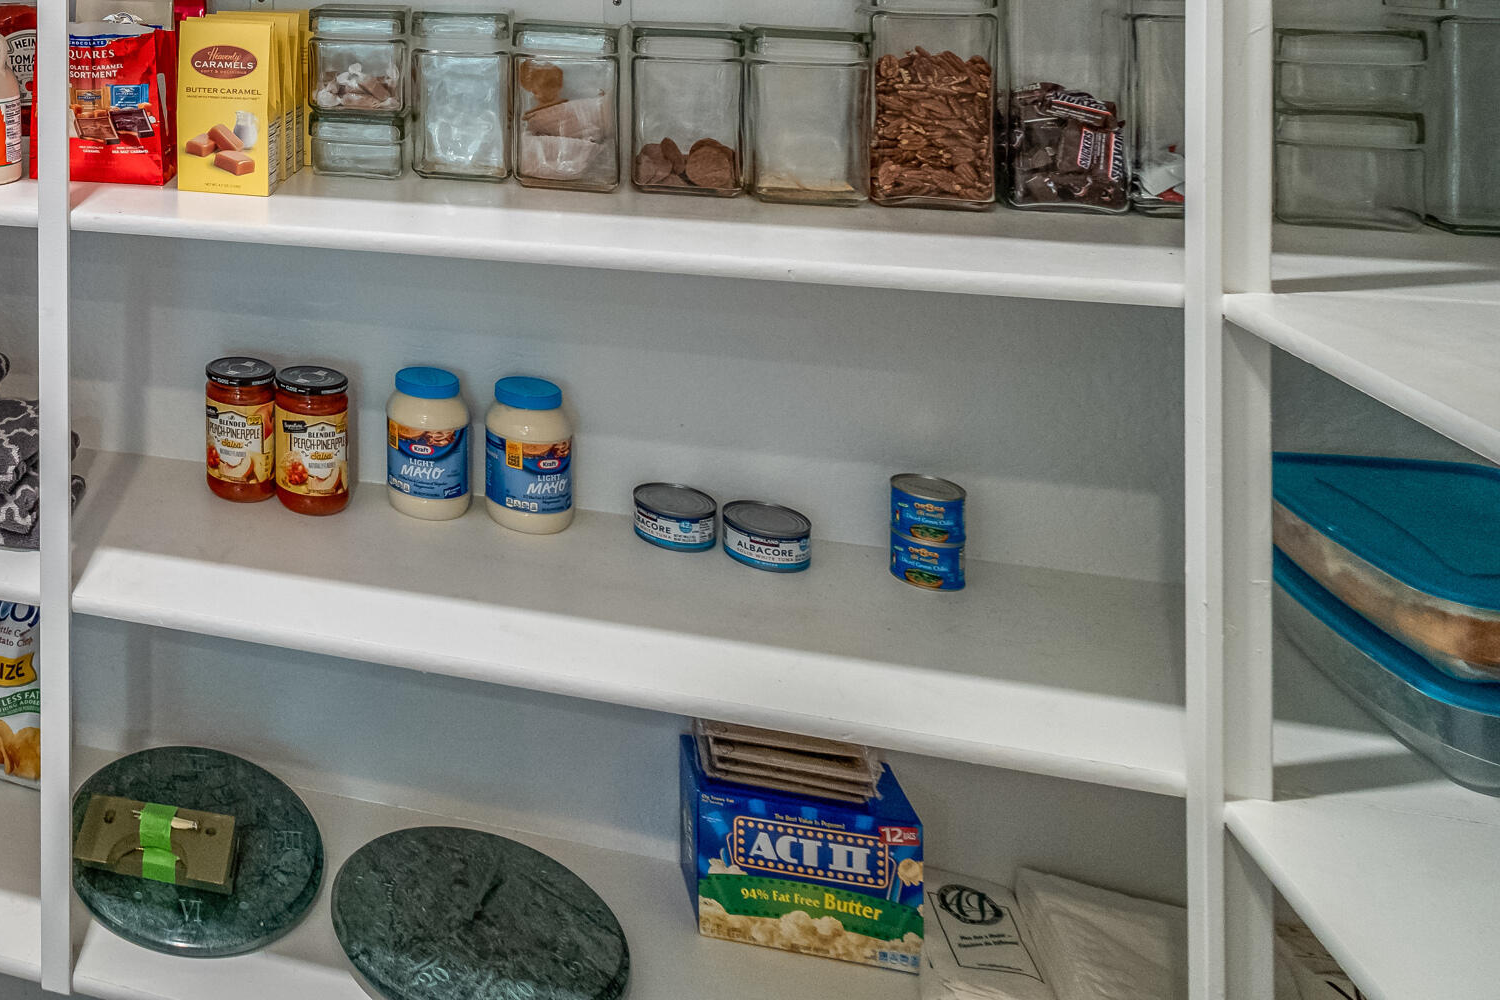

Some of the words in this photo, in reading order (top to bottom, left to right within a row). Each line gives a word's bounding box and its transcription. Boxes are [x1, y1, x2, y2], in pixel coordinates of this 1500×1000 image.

[207, 47, 241, 61] Heavenly
[92, 63, 124, 71] CARAMEL
[194, 60, 254, 69] CARAMELS
[1080, 130, 1094, 169] SNICKERS
[219, 418, 246, 427] BLENDED
[209, 421, 260, 440] PEACH-PINEAPPLE
[221, 438, 243, 448] Salsa
[413, 445, 430, 453] Kraft
[311, 451, 333, 460] Salsa
[409, 458, 435, 467] LIGHT
[400, 464, 445, 480] MAYO
[537, 474, 561, 482] LIGHT
[526, 479, 568, 495] MAYO
[635, 513, 671, 534] LBACORE
[737, 540, 794, 557] ALBACORE
[2, 694, 22, 706] LESS
[798, 816, 813, 826] Value
[881, 827, 904, 843] 12
[749, 831, 822, 868] ACT
[828, 843, 871, 876] II
[740, 888, 769, 900] 94%
[773, 890, 791, 902] Fat
[794, 893, 821, 909] Free
[824, 893, 883, 921] Butter
